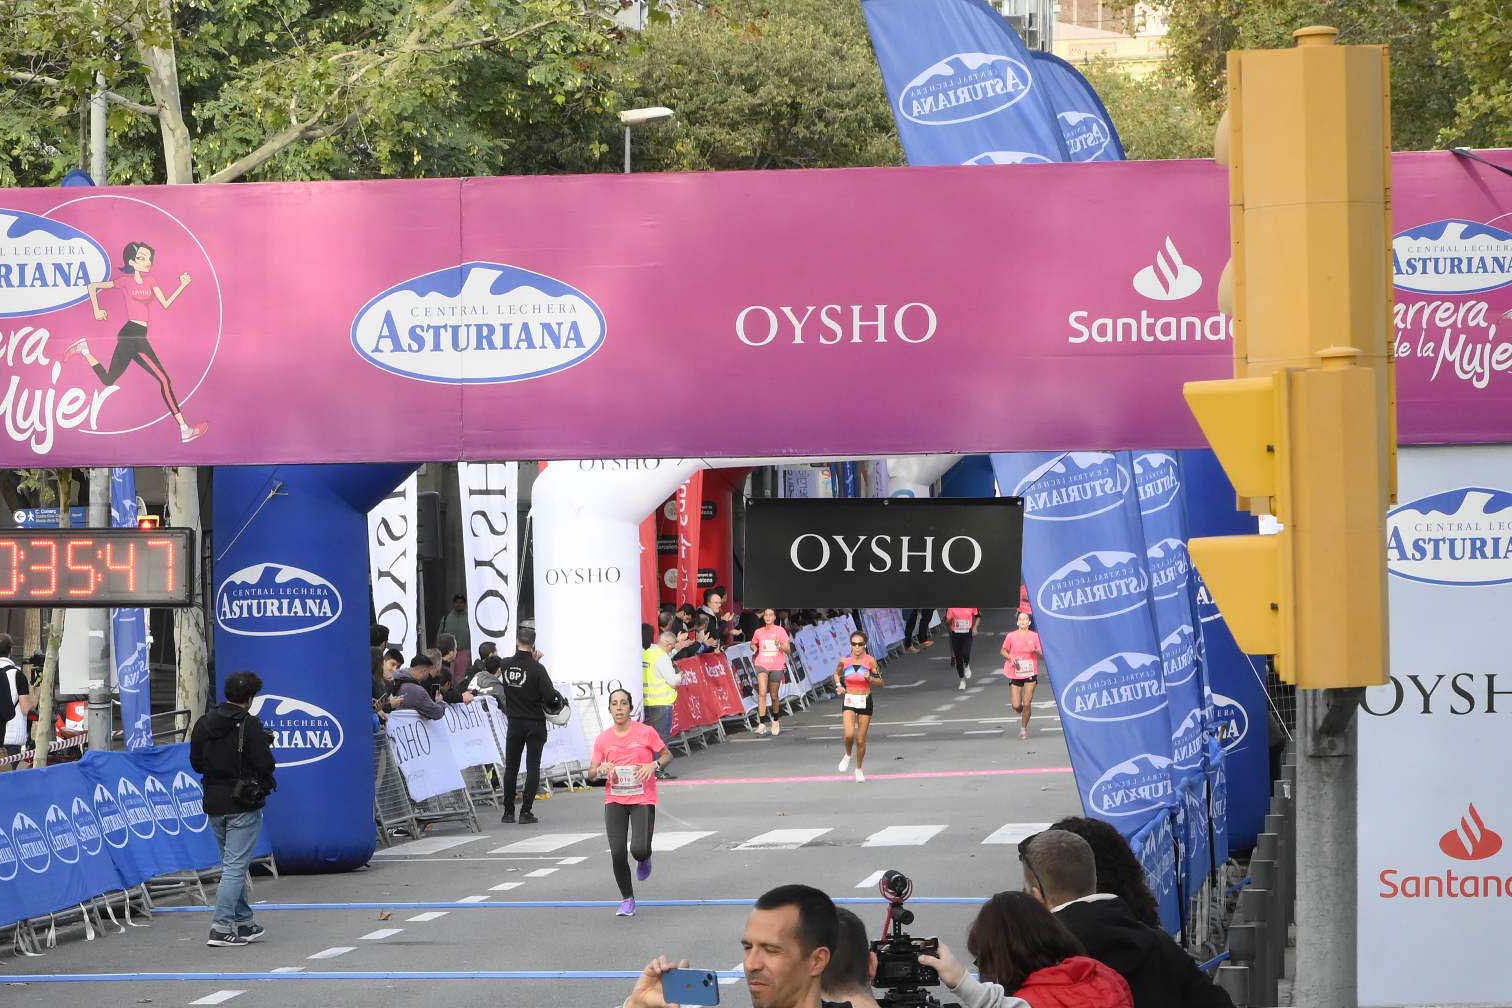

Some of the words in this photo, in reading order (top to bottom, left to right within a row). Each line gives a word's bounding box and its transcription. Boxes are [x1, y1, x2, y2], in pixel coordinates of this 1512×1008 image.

[13, 245, 86, 256] LECHERA
[410, 306, 488, 318] CENTRAL
[496, 303, 578, 315] LECHERA
[371, 309, 587, 354] ASTURIANA
[735, 303, 937, 346] OYSHO
[1417, 330, 1435, 357] la
[1430, 324, 1512, 389] Muje
[1414, 523, 1481, 532] CENTRAL
[790, 533, 982, 574] OYSHO
[546, 566, 621, 585] OYSHO
[232, 588, 275, 596] CENTRAL
[279, 588, 328, 596] LECHERA
[220, 594, 332, 620] ASTURIANA
[509, 671, 522, 681] BP
